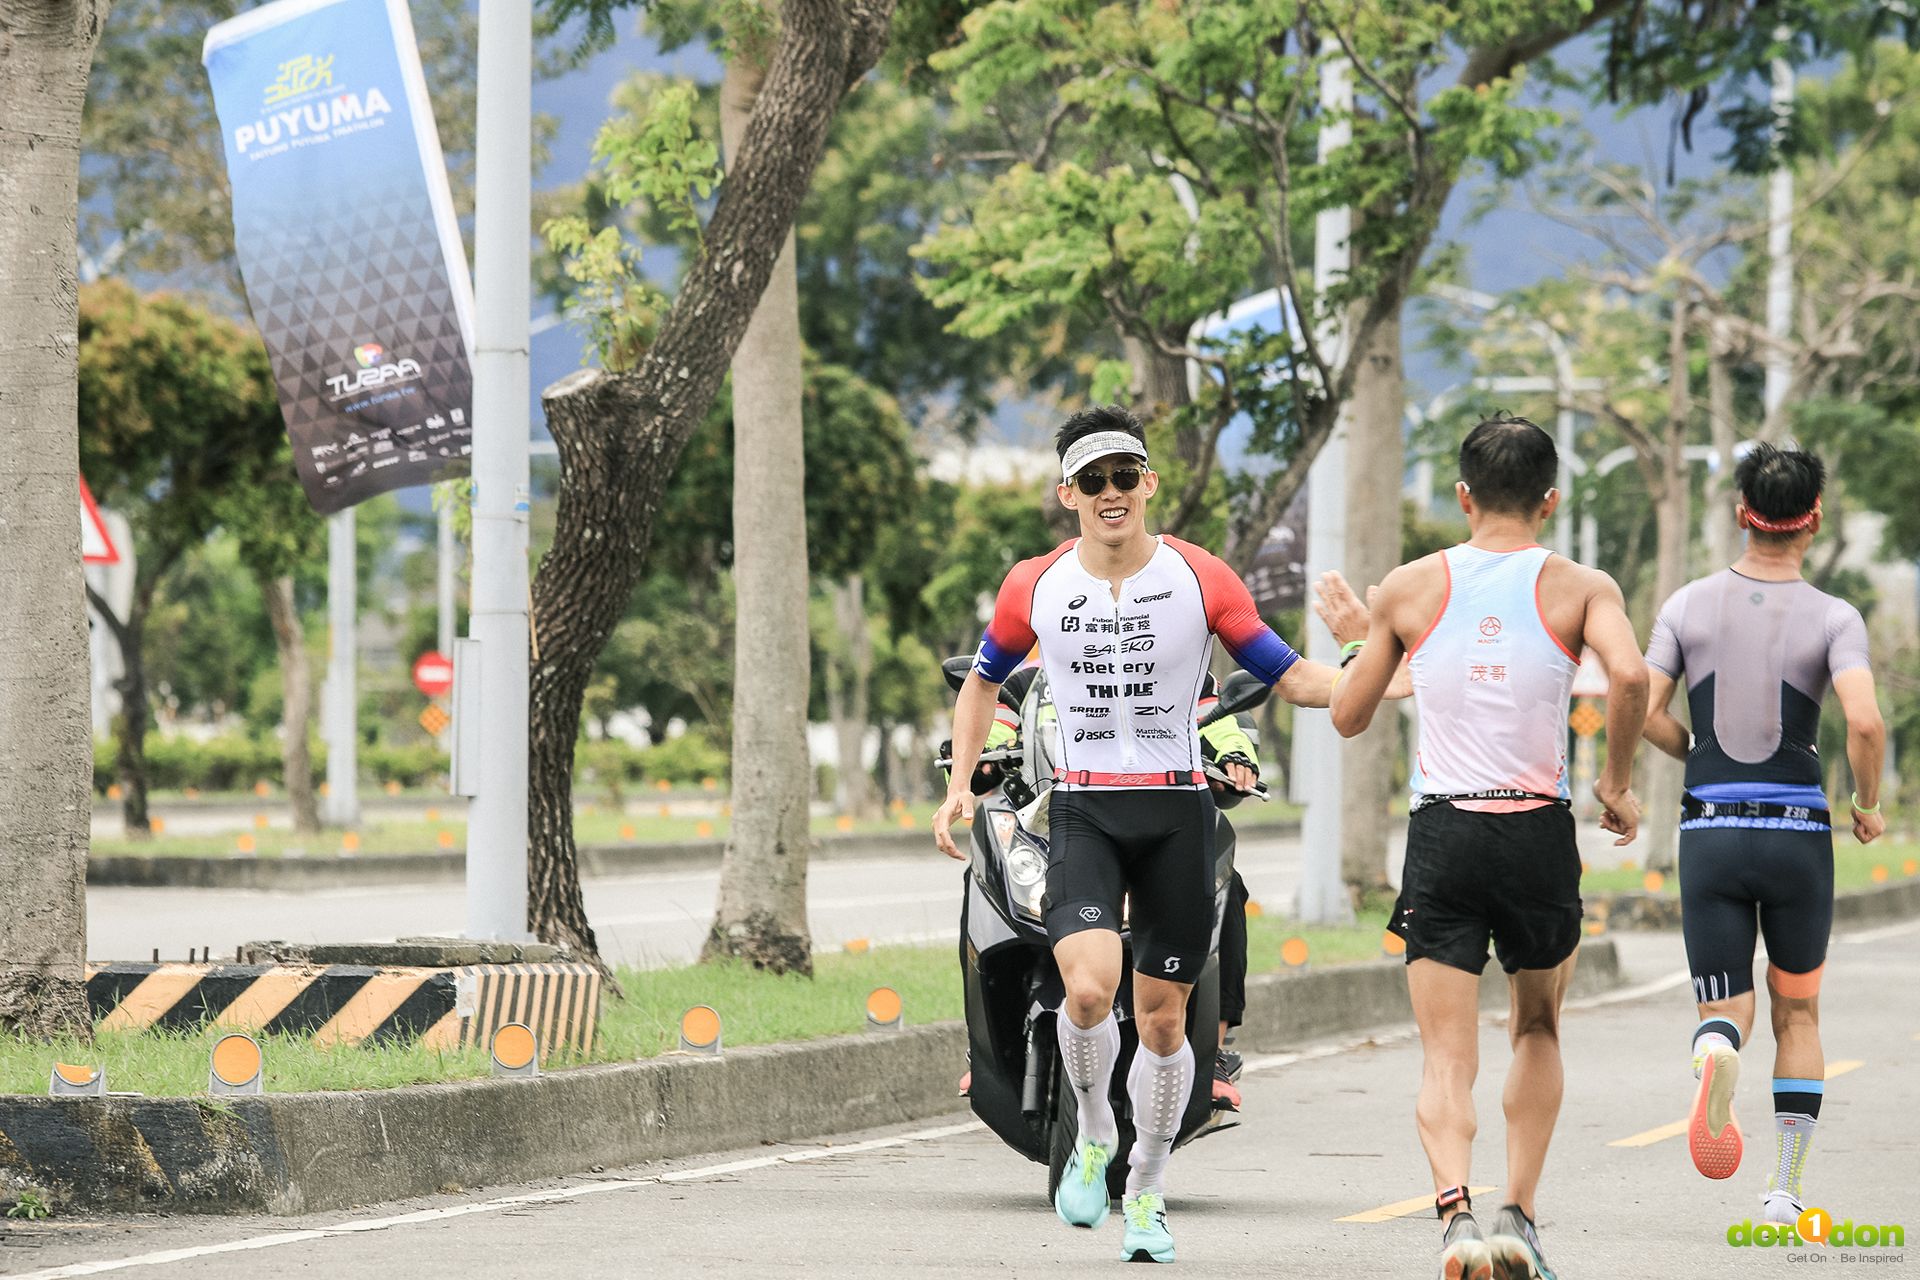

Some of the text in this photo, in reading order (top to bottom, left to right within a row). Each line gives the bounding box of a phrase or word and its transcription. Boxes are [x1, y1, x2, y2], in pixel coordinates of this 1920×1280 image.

[235, 88, 392, 154] PUYUMA
[1133, 591, 1173, 604] VERGE
[1085, 620, 1151, 633] 富邦金控
[1470, 665, 1508, 682] 茂哥
[1086, 682, 1154, 698] THULE
[1134, 705, 1175, 715] ZIV
